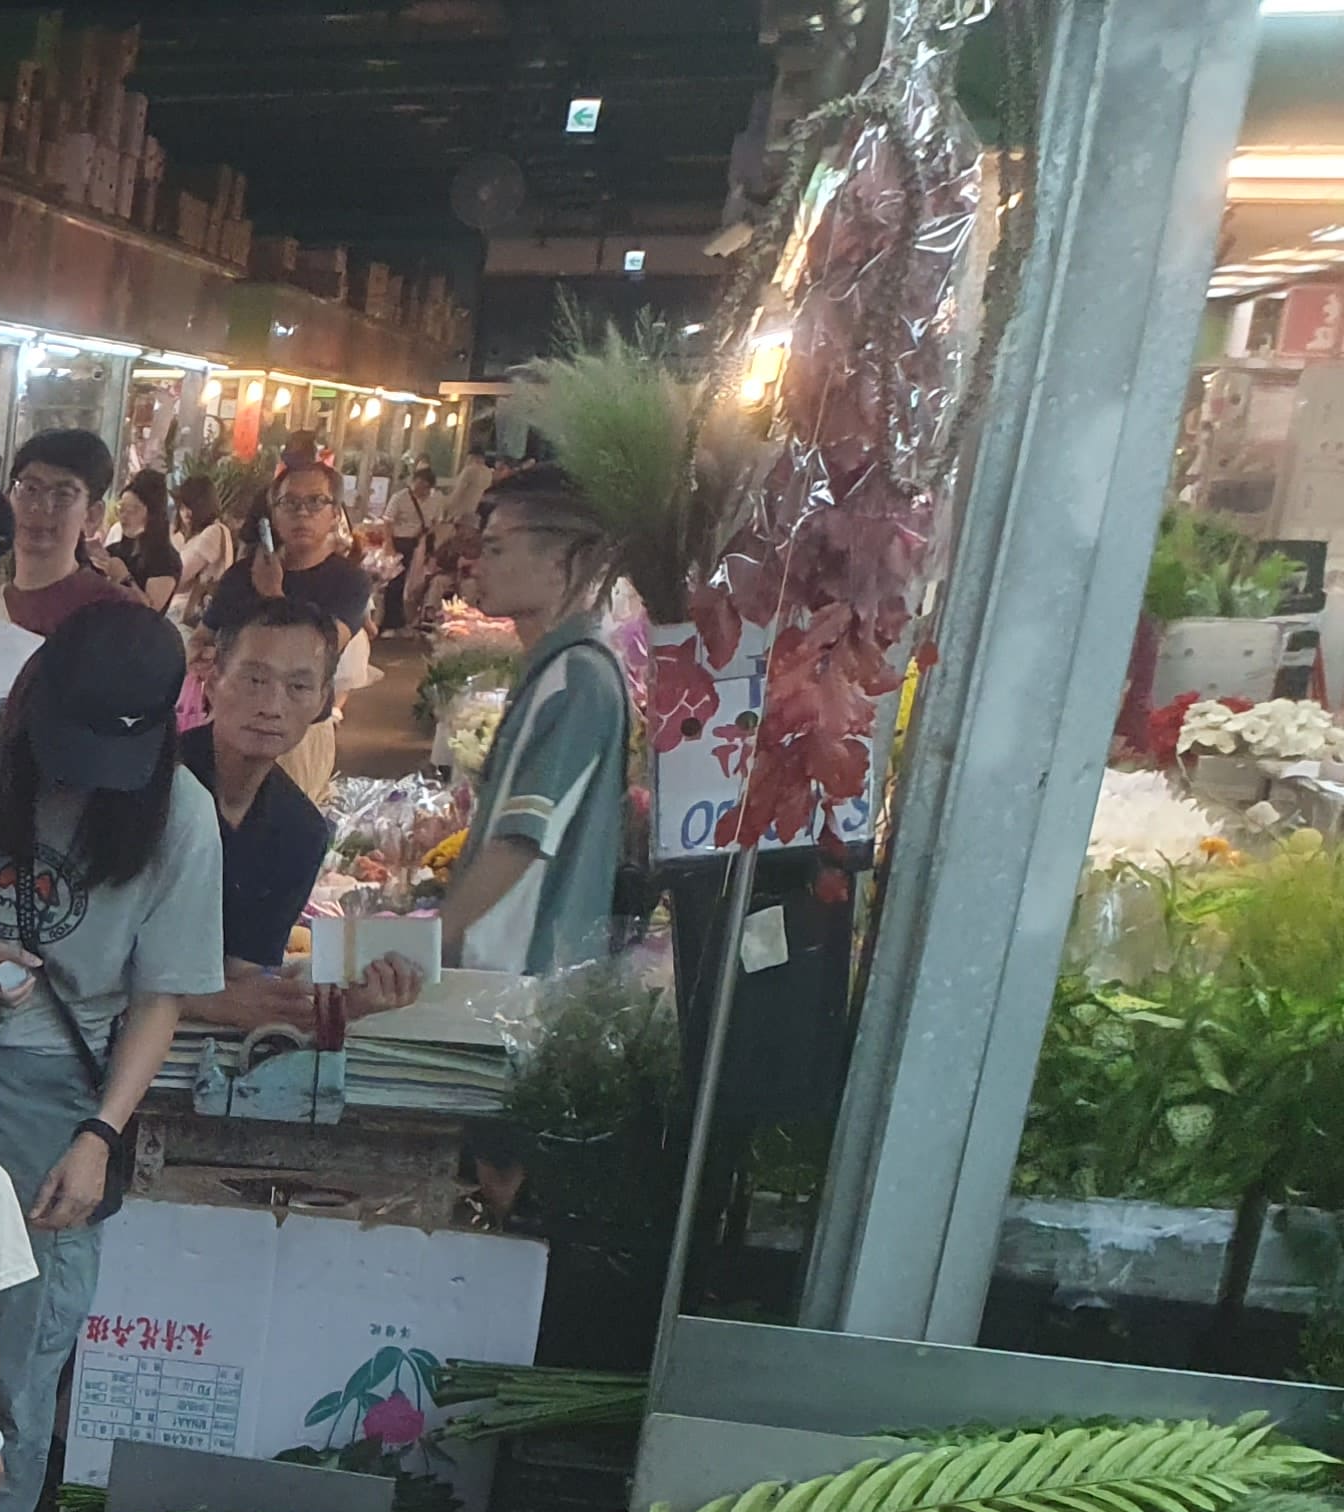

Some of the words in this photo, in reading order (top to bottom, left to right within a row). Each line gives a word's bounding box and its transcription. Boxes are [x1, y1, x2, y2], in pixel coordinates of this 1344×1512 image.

[86, 1315, 213, 1356] 永清花卉班
